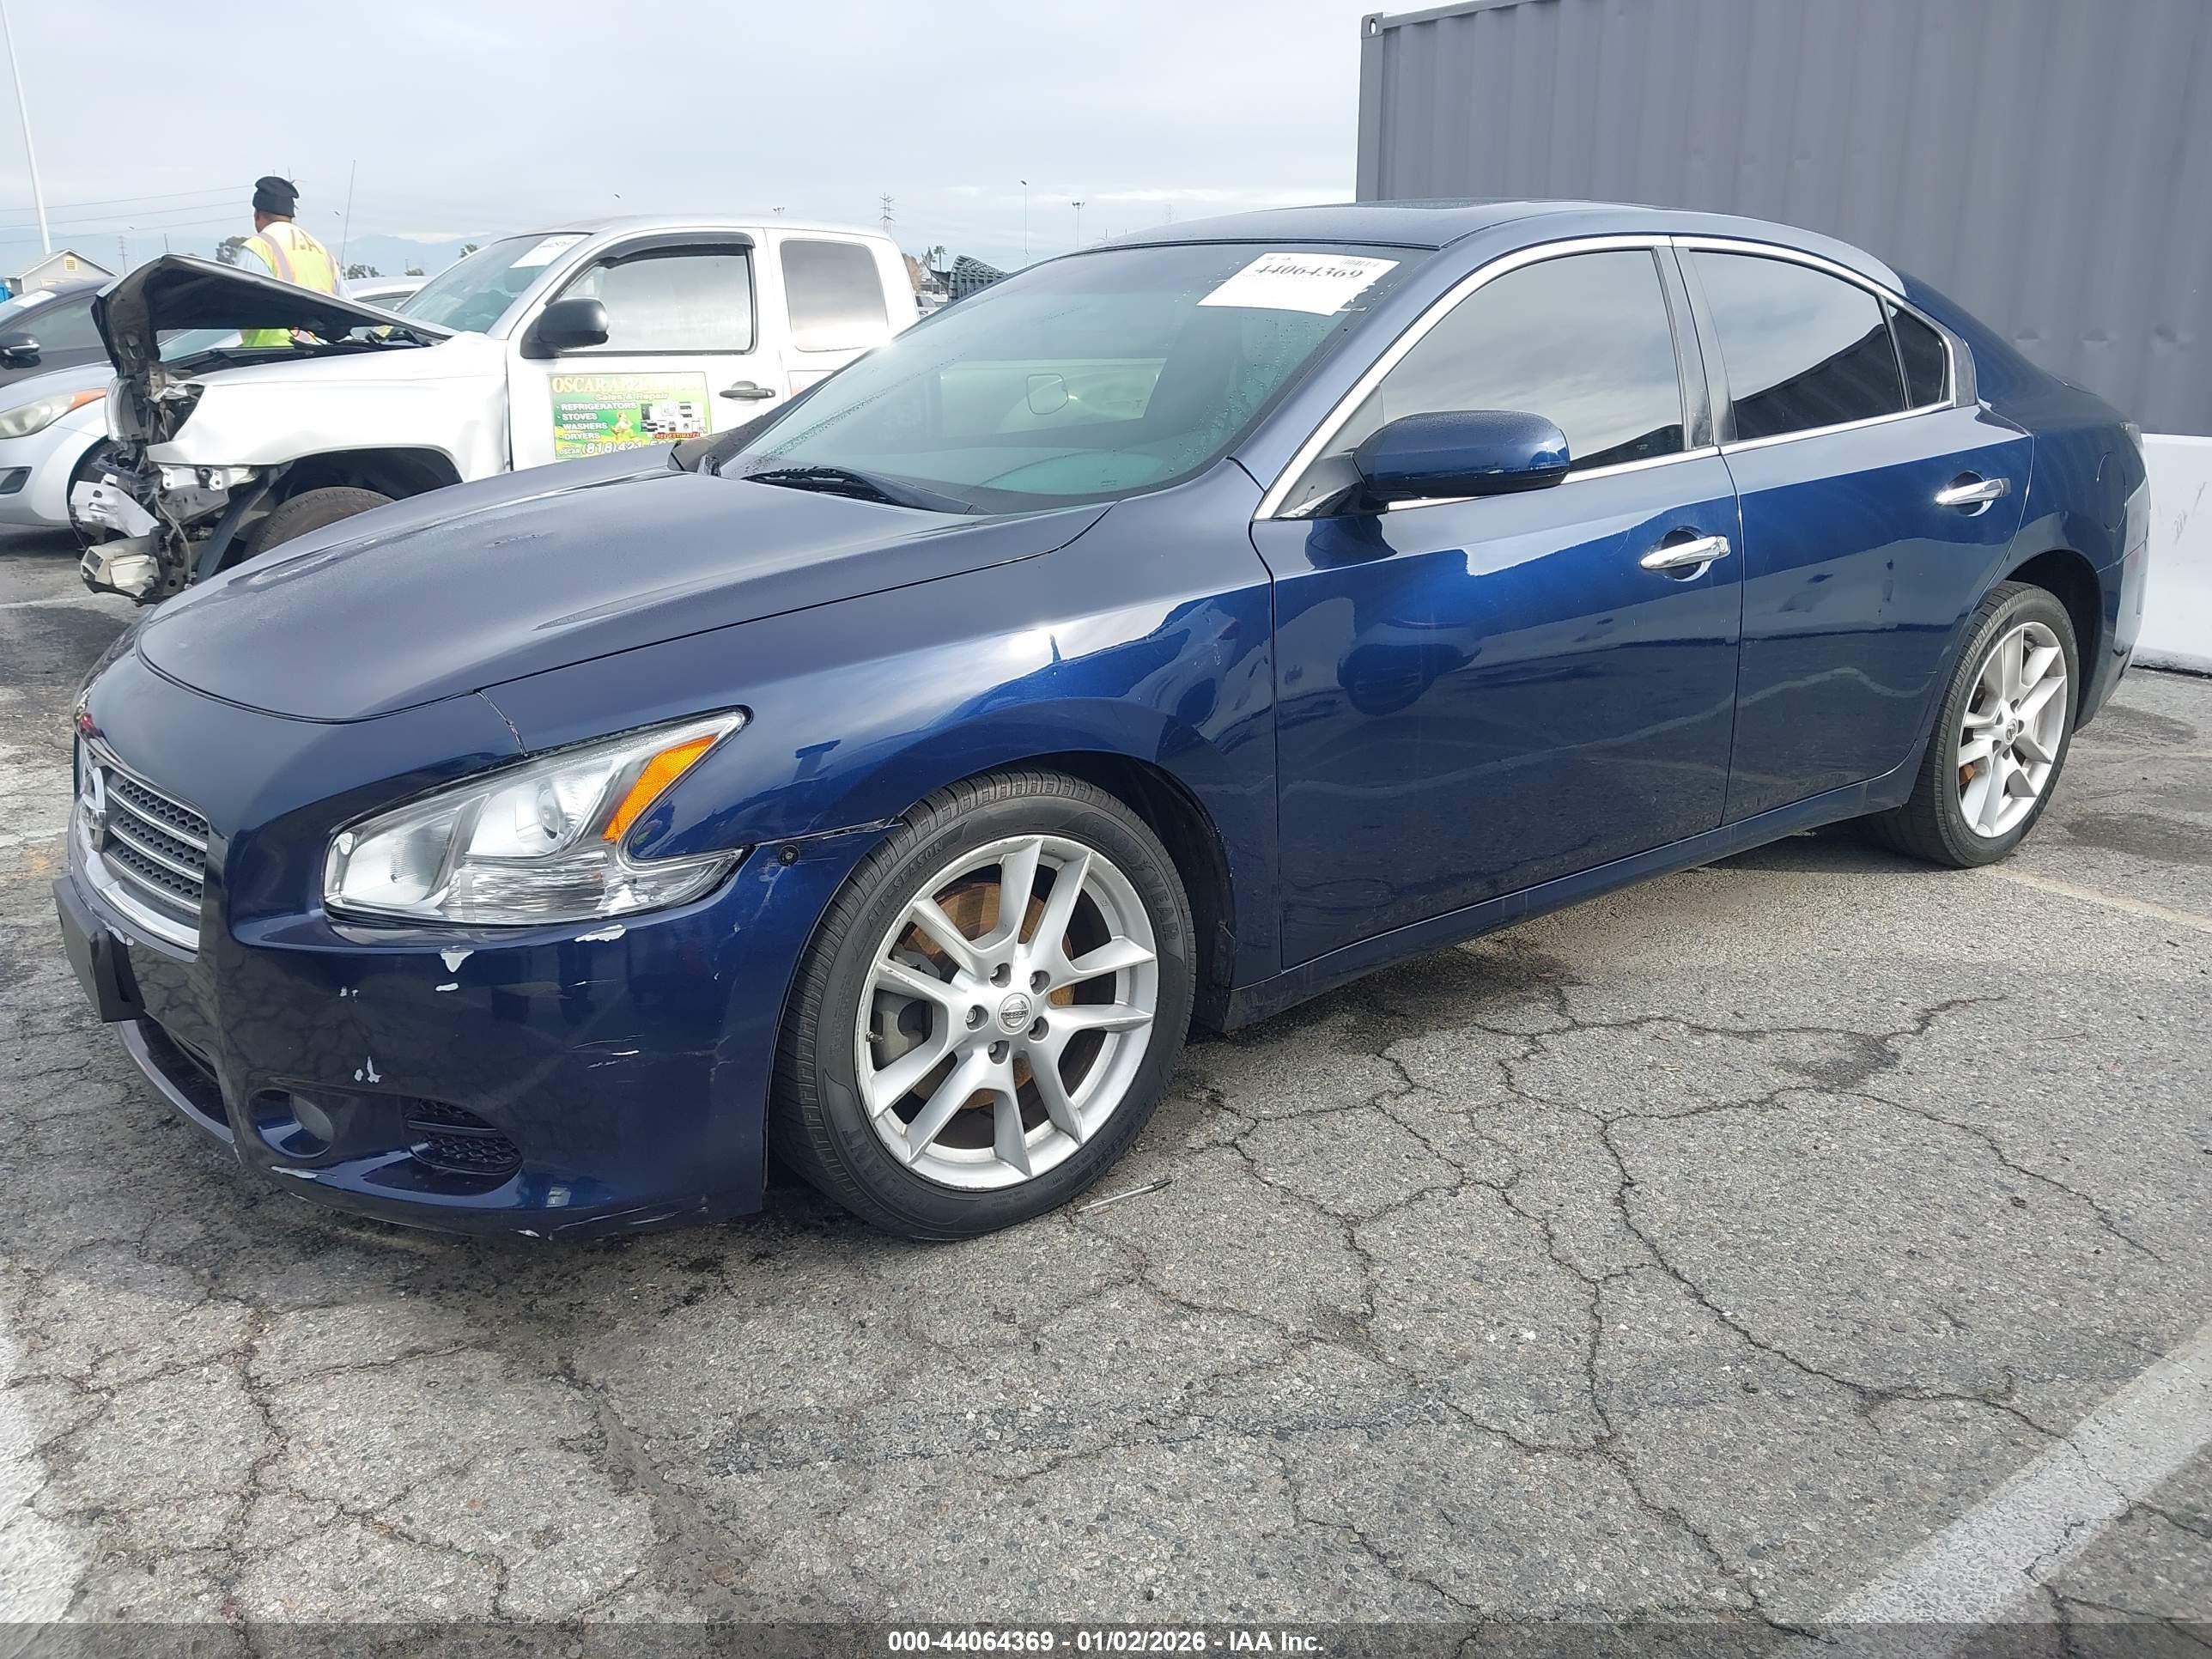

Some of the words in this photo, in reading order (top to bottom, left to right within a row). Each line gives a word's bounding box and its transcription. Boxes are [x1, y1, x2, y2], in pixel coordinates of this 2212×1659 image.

[552, 376, 605, 393] OSCAR
[562, 412, 598, 421] STOVES
[563, 422, 608, 430] WASHERS
